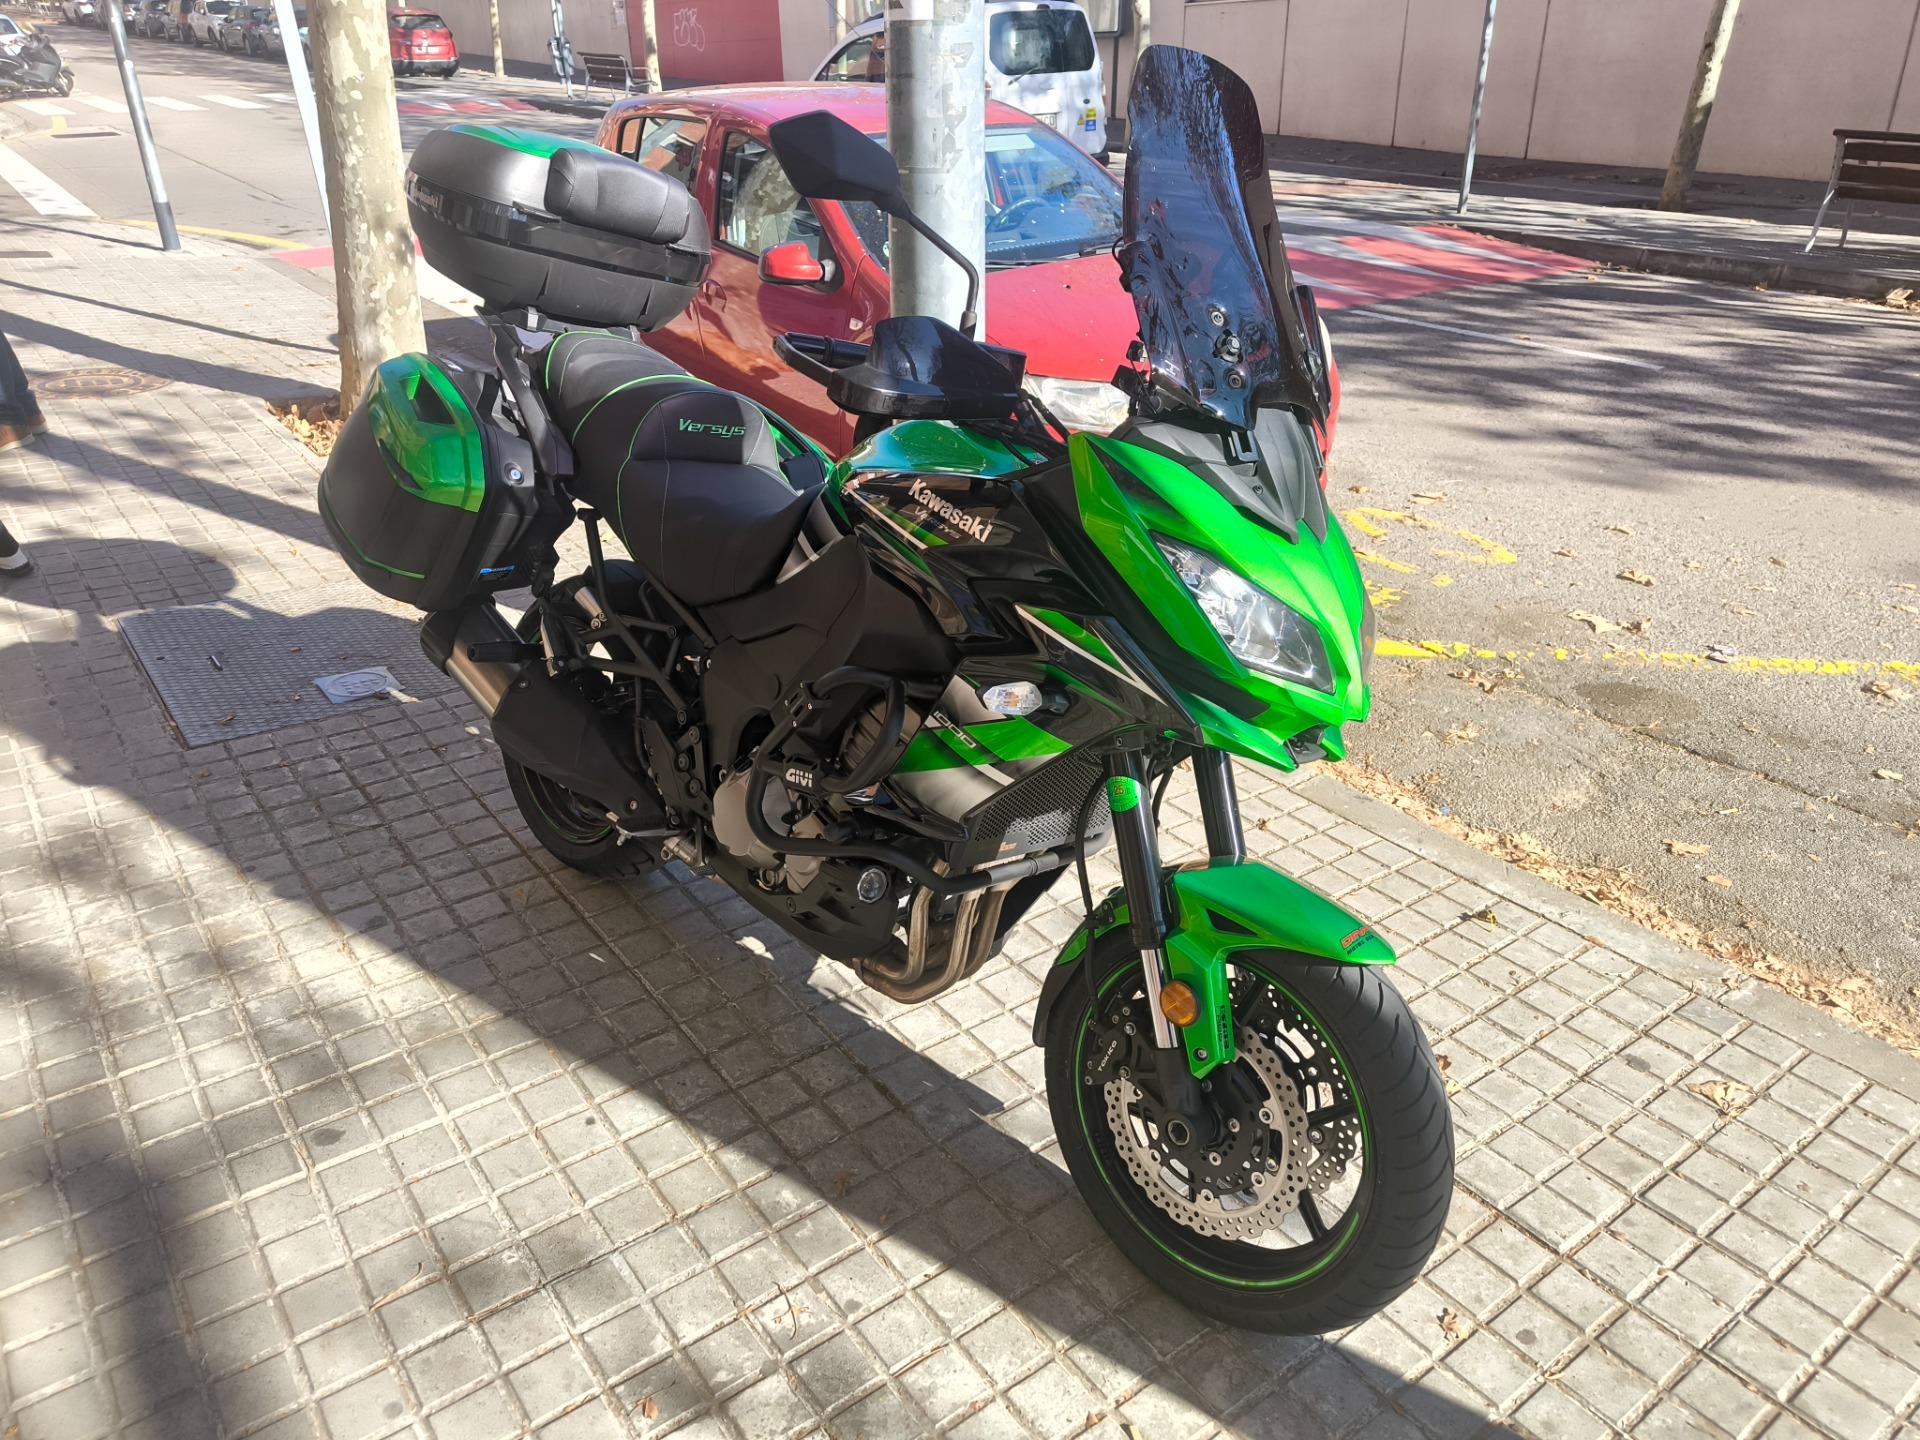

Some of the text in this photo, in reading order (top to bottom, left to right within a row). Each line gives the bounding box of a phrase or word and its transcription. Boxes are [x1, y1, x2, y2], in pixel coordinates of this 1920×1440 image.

[679, 418, 746, 438] Versys
[908, 478, 994, 543] Kawasaki
[933, 710, 977, 749] 1000
[785, 768, 813, 788] GIVI
[1097, 1040, 1118, 1072] TOKICO
